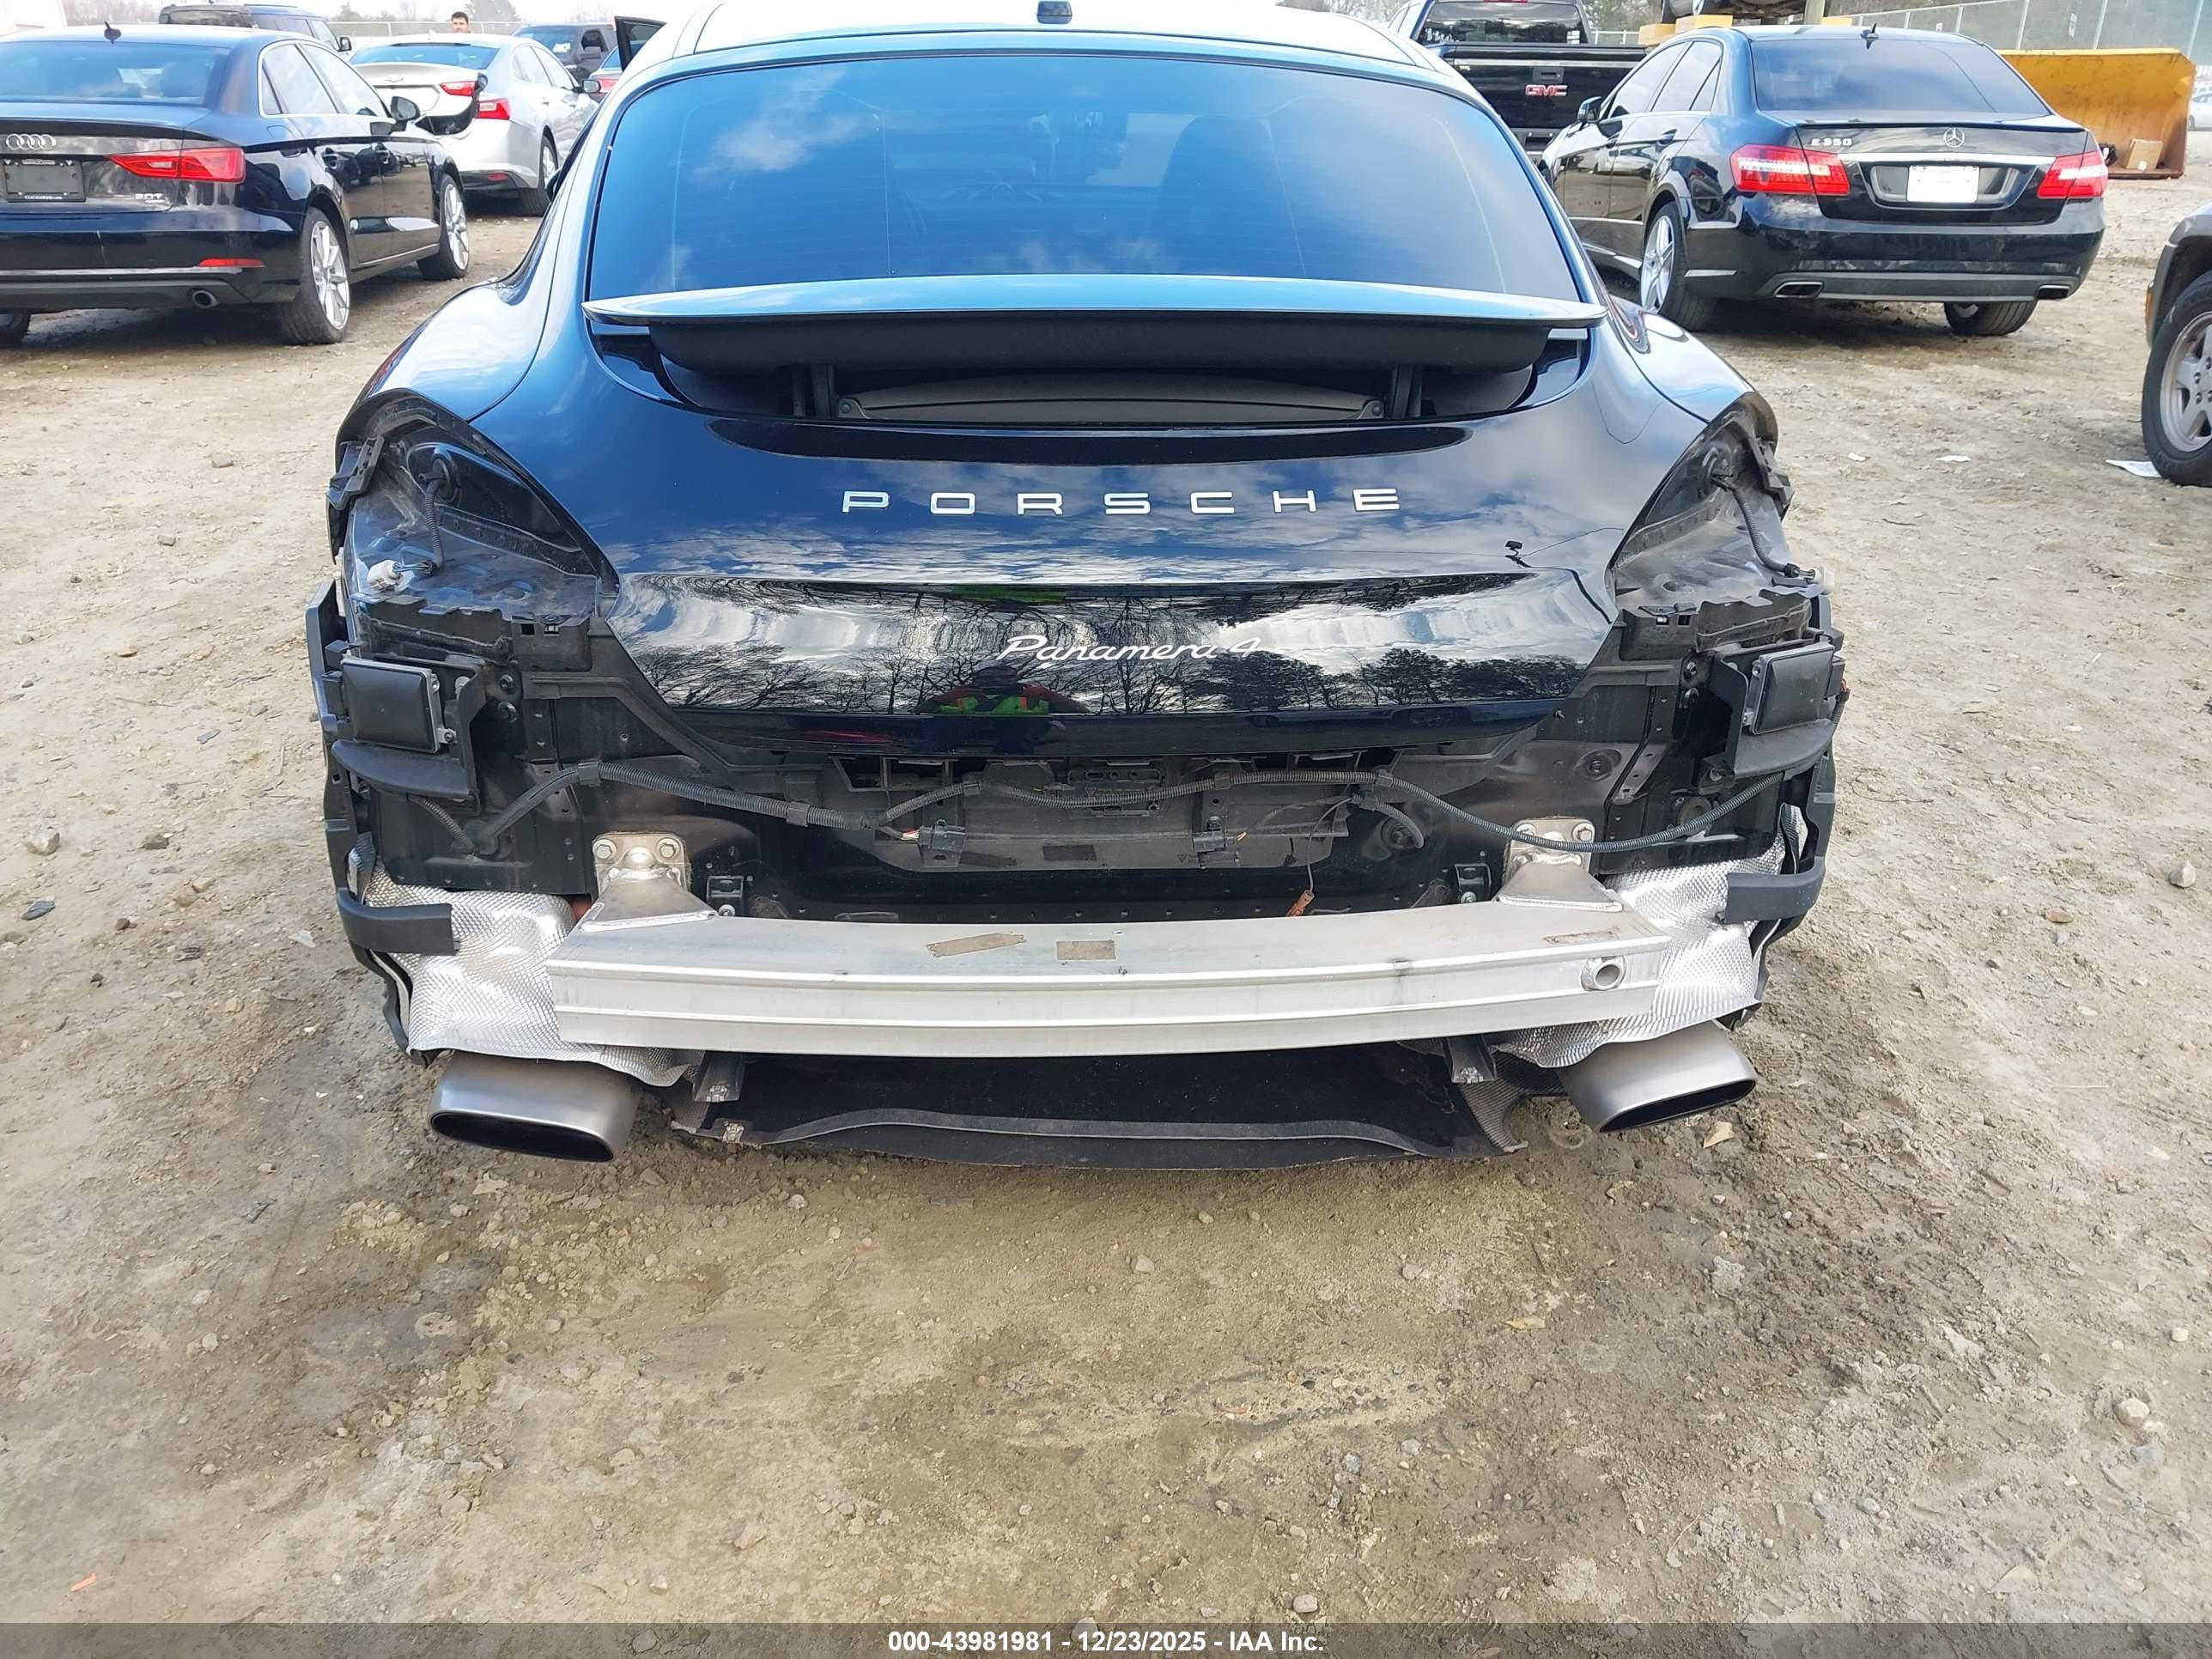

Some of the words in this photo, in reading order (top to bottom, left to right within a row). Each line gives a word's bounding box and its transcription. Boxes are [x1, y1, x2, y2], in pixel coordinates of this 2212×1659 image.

[1525, 84, 1568, 97] GMC
[1811, 137, 1820, 146] E
[1822, 137, 1852, 146] 350
[841, 488, 1401, 515] PORSCHE
[995, 634, 1220, 661] Panamera
[1228, 637, 1262, 658] 4
